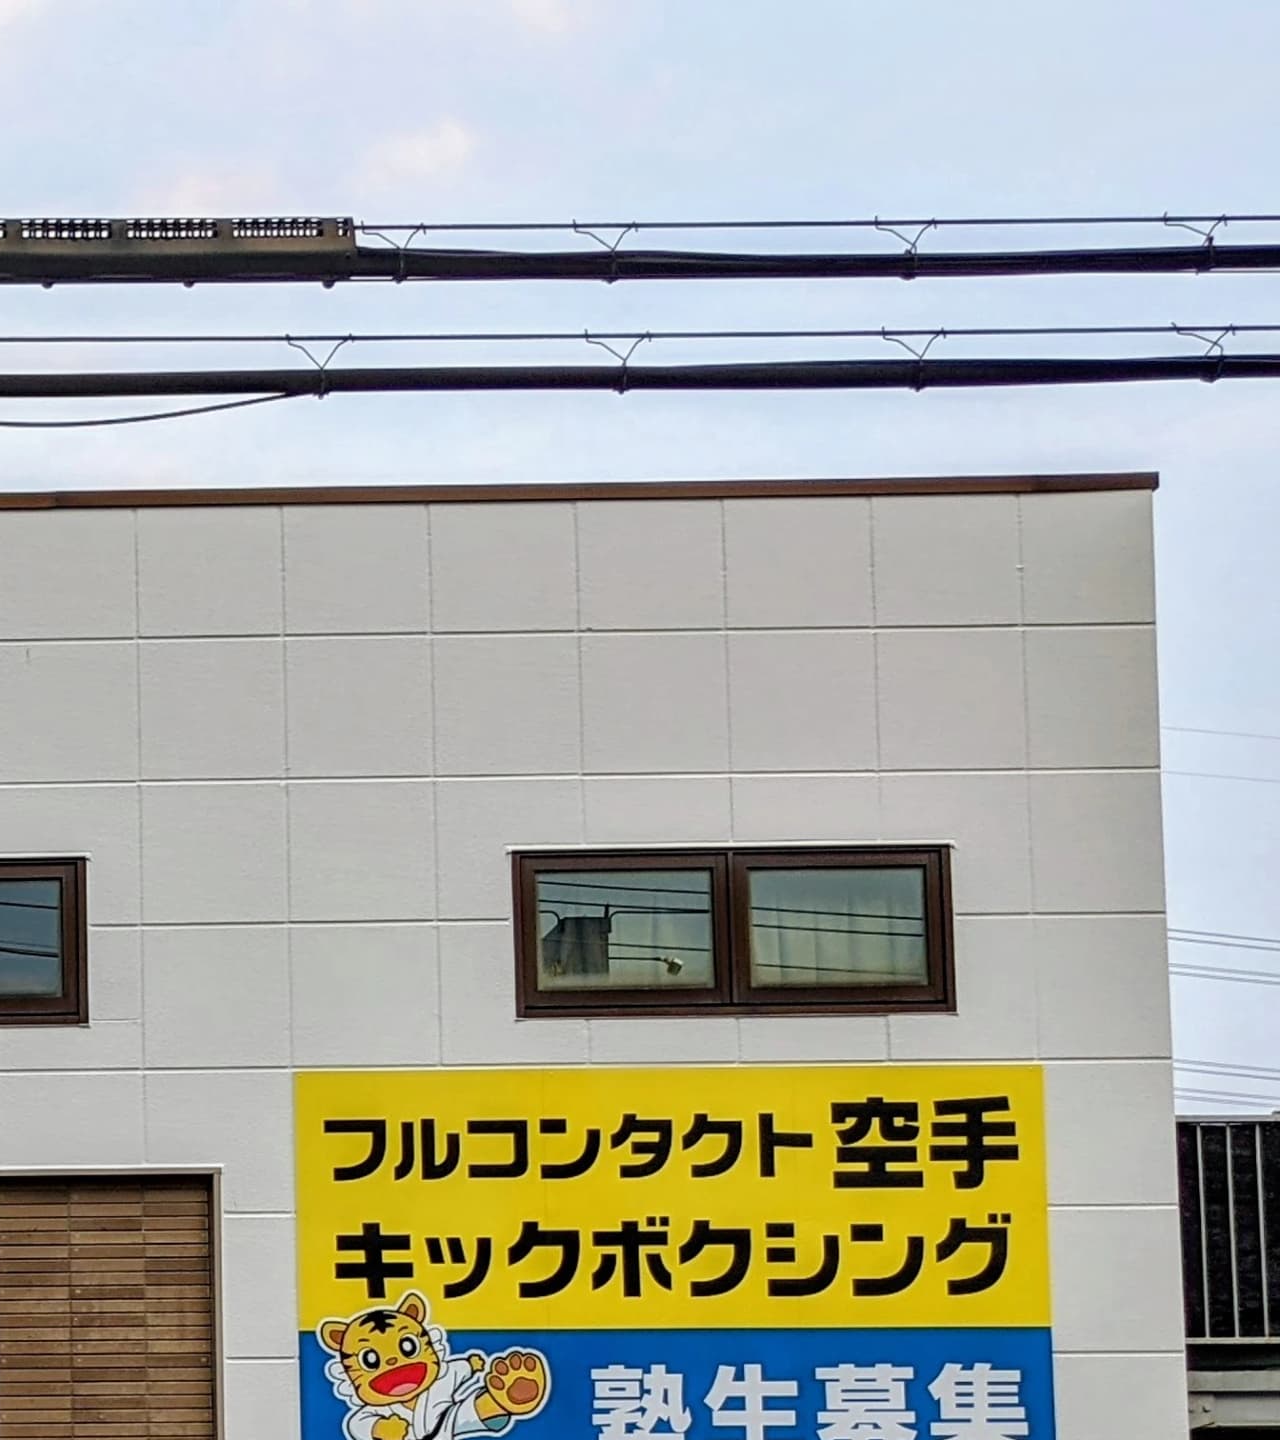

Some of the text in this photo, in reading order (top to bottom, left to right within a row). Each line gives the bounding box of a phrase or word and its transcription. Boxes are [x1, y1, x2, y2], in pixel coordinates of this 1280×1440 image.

[323, 1095, 1020, 1190] フルコンタクト 空手
[334, 1213, 1012, 1299] キックボクシング
